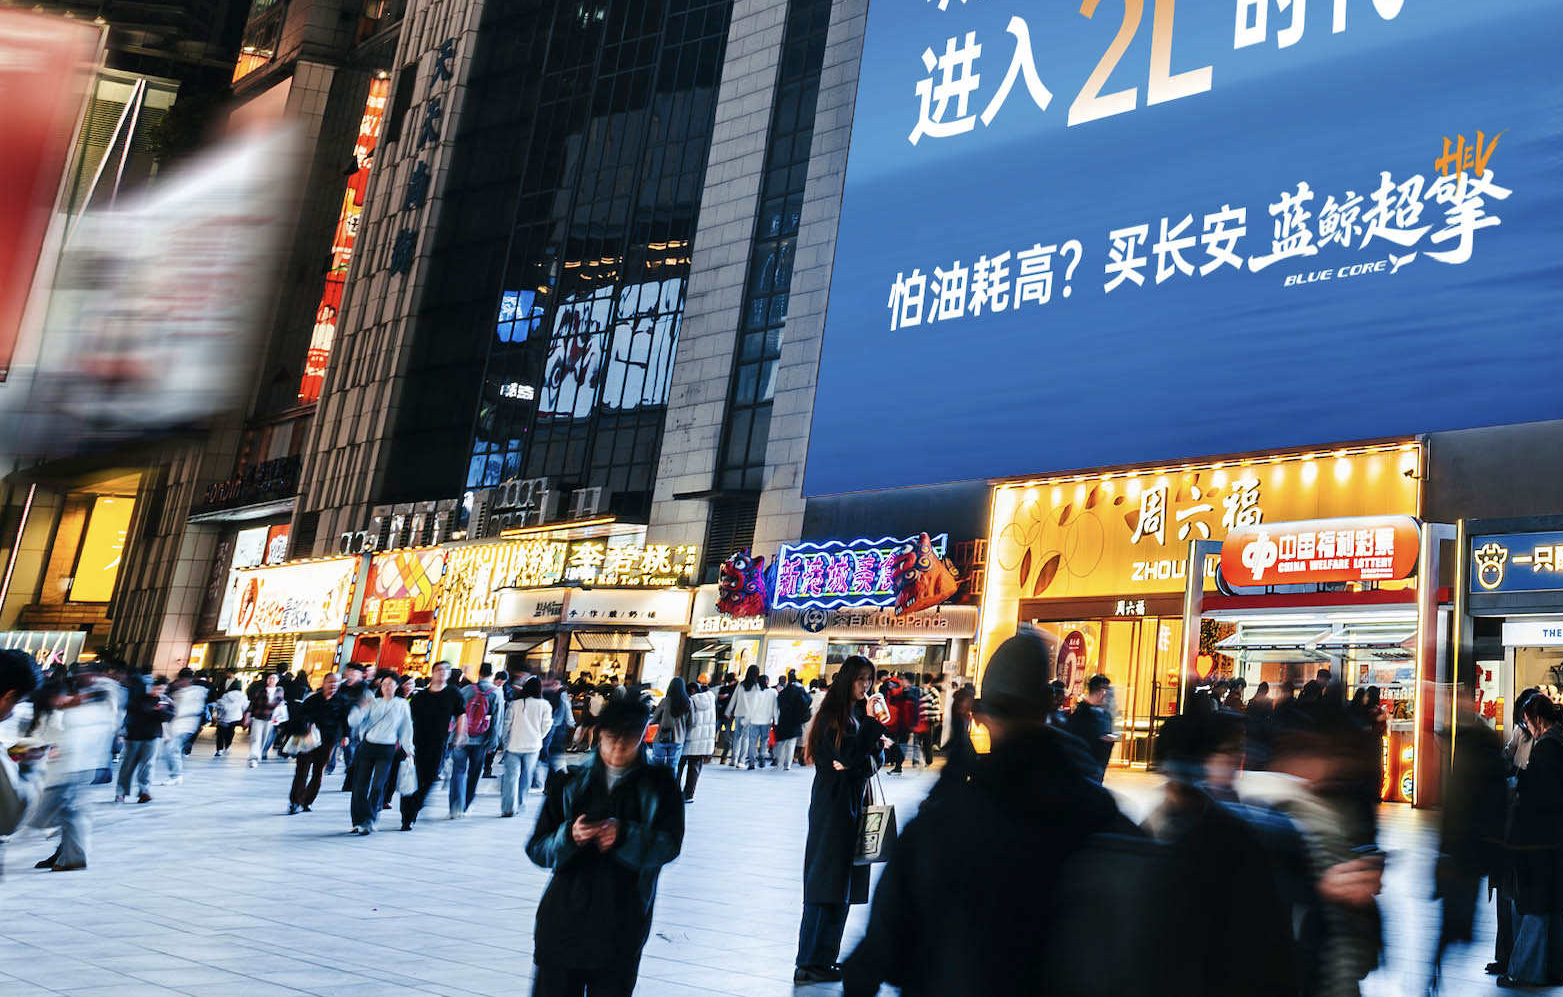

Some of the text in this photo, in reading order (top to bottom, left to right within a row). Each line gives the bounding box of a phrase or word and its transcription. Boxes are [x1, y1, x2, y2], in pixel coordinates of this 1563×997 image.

[1435, 130, 1509, 180] HEV
[1284, 260, 1387, 287] BLUE CORE
[1131, 477, 1264, 546] 周六福
[1279, 528, 1394, 560] 中国福利彩票
[1309, 559, 1349, 570] WELFARE
[1543, 629, 1563, 638] THE
